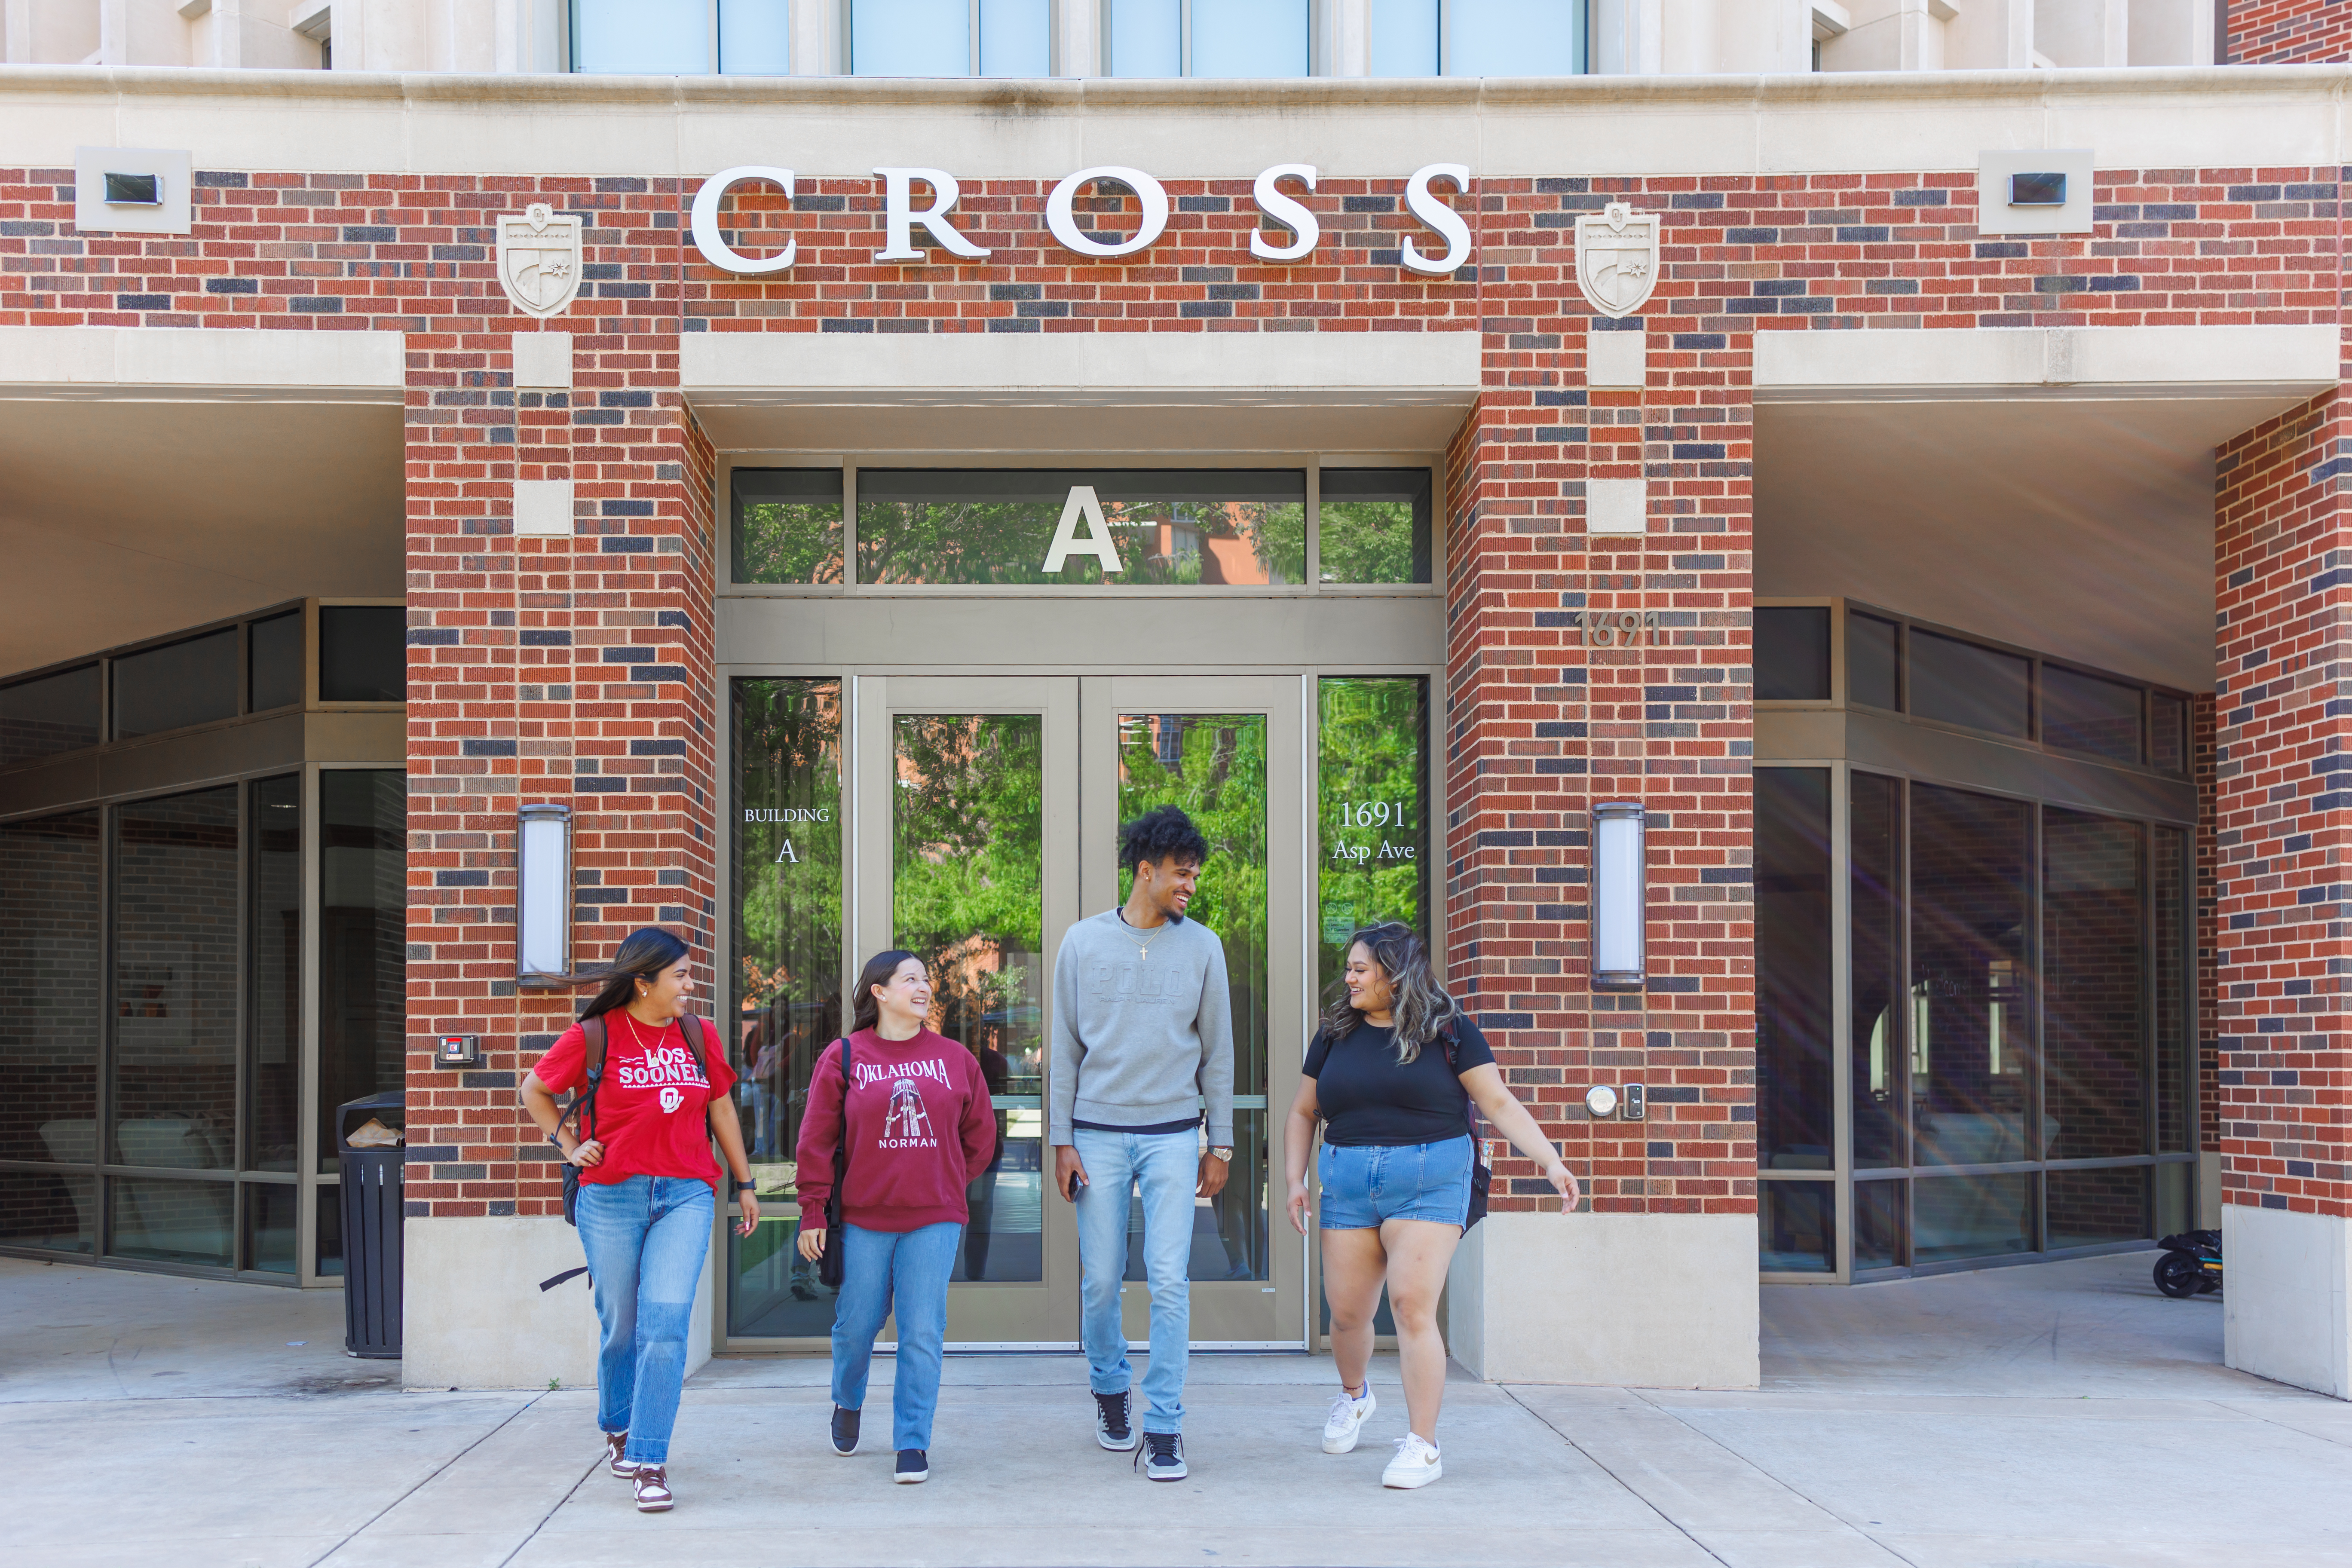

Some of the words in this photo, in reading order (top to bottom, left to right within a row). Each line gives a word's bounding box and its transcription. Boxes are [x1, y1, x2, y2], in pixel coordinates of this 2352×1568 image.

[690, 163, 1472, 276] CROSS
[1042, 486, 1124, 572] A
[1575, 611, 1660, 646] 1691
[744, 808, 830, 822] BUILDING
[1341, 802, 1404, 827] 1691
[775, 838, 799, 863] A
[1332, 840, 1371, 865] Asp
[1377, 839, 1415, 858] Ave
[1091, 962, 1186, 997] POLO
[1135, 996, 1175, 1004] LAUREN
[644, 1047, 686, 1068] LOS
[856, 1058, 952, 1090] OKLAHOMA
[879, 1138, 937, 1148] NORMAN
